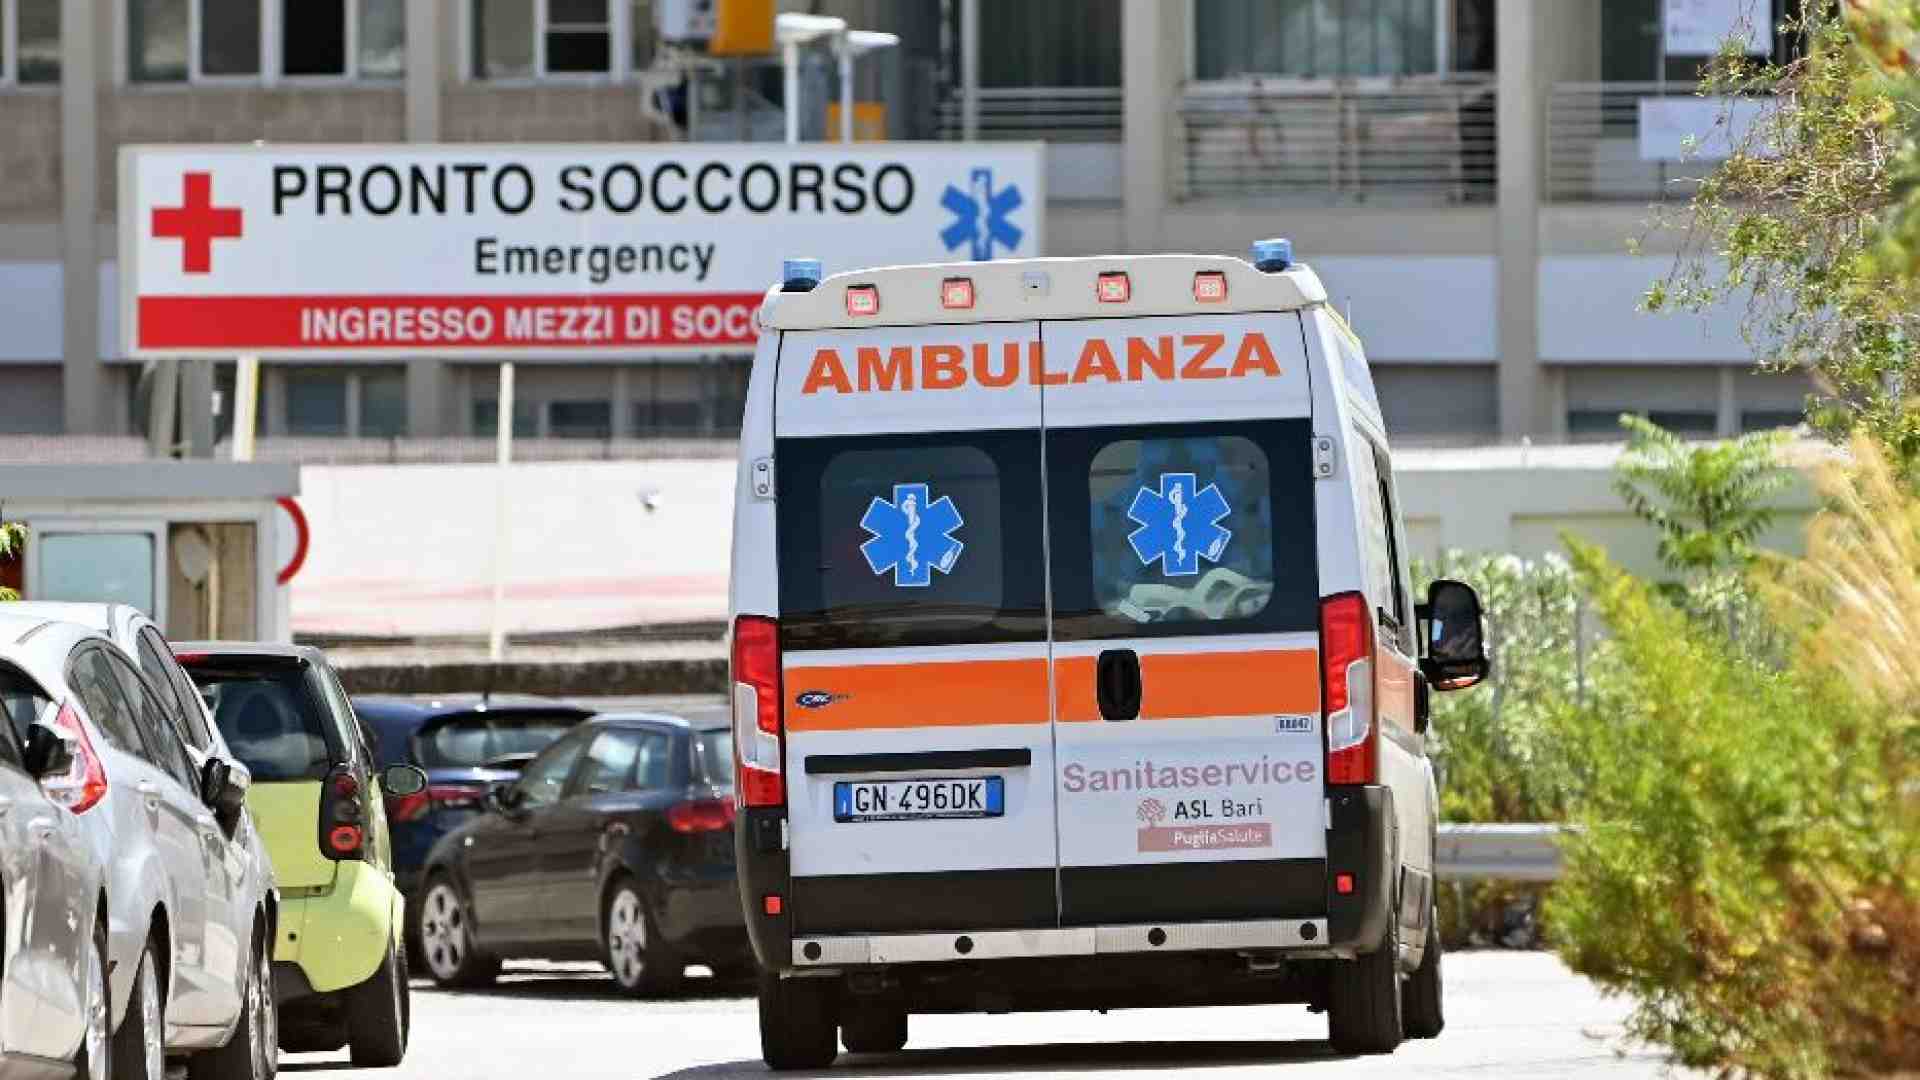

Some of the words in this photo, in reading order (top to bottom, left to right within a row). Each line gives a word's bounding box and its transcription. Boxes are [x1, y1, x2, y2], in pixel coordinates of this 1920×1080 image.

[273, 163, 535, 216] PRONTO
[559, 161, 915, 215] SOCCORSO
[475, 237, 716, 284] Emergency
[301, 306, 494, 341] INGRESSO
[504, 306, 613, 340] MEZZI
[625, 305, 660, 339] DI
[801, 332, 1282, 395] AMBULANZA
[1063, 754, 1316, 793] Sanitaservice
[1174, 800, 1214, 819] ASL
[1222, 798, 1263, 817] Bari
